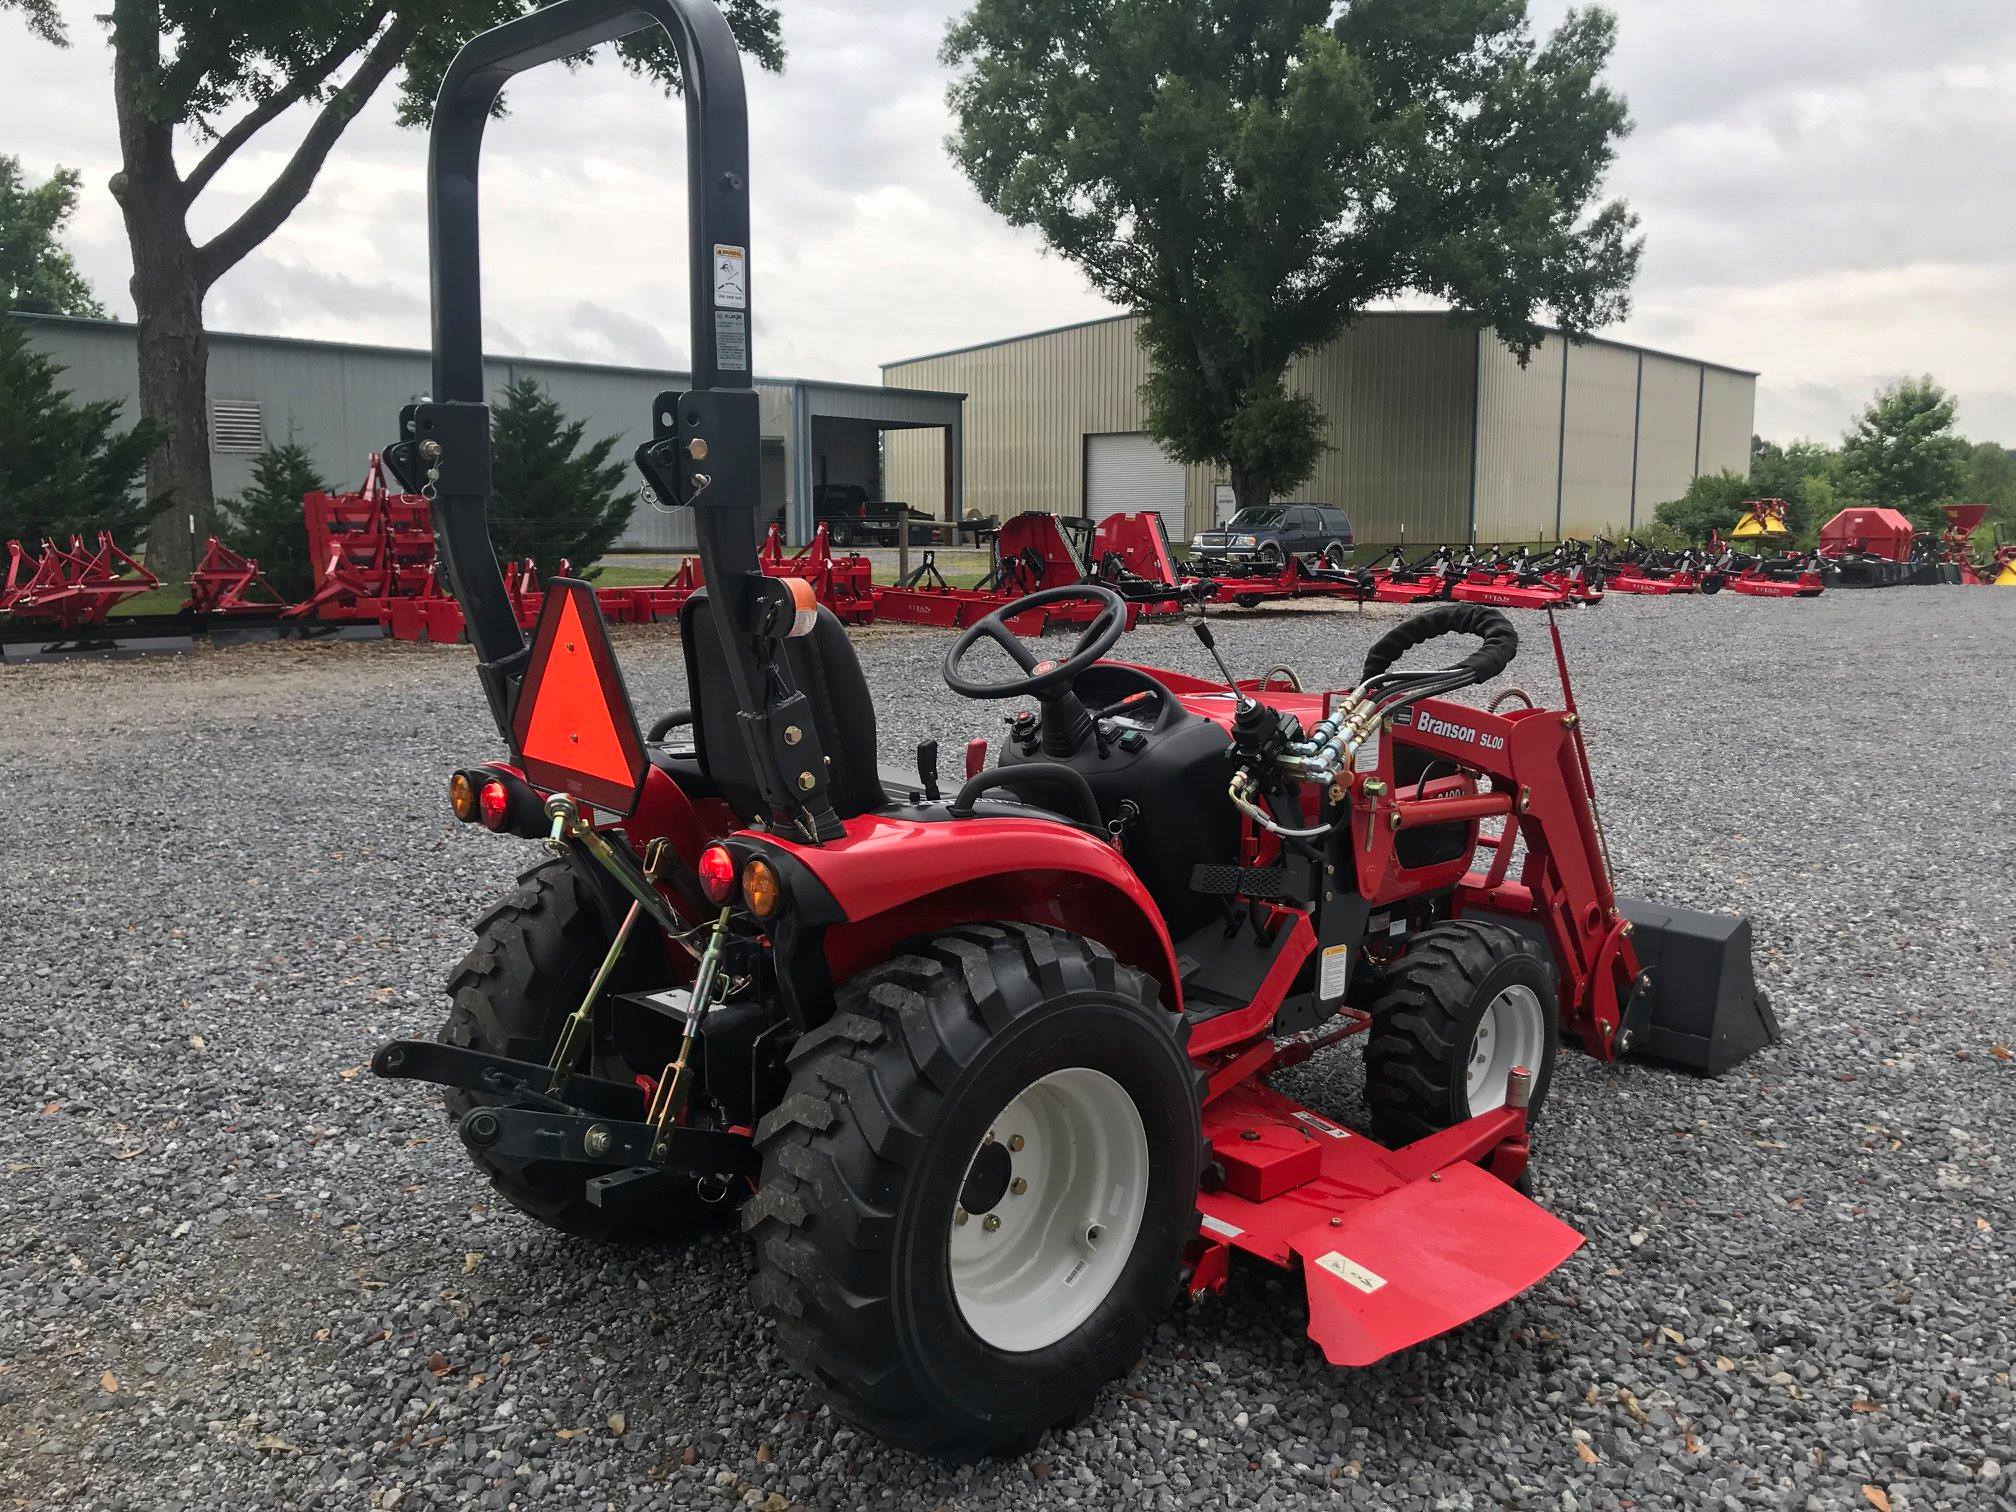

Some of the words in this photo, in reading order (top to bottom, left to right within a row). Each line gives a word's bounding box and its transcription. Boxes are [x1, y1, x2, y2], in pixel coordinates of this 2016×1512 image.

[1482, 593, 1510, 602] TITAN
[908, 604, 932, 614] TITAN
[1417, 710, 1477, 743] Branson
